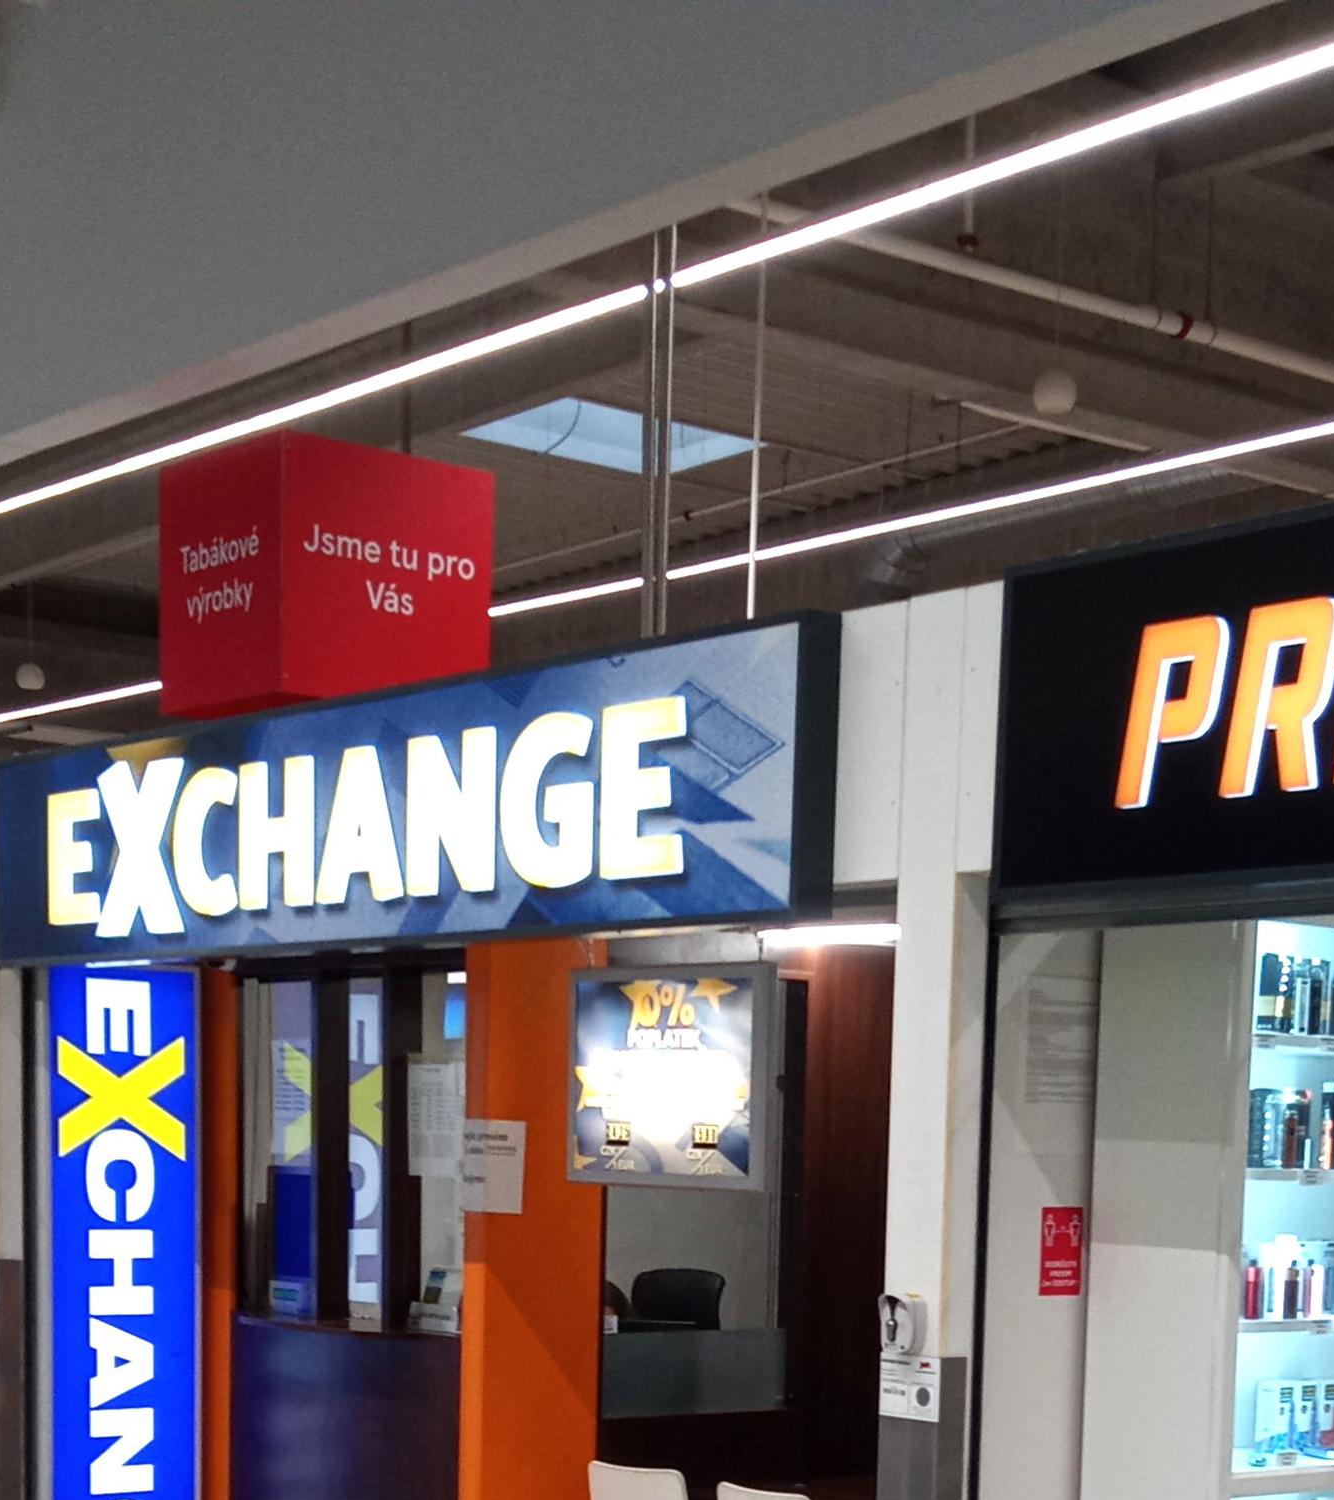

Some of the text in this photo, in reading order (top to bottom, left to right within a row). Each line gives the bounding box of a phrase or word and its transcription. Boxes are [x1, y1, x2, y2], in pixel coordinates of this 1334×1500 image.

[180, 525, 260, 574] Tabákové
[303, 523, 476, 581] Jsme tu pro
[186, 579, 253, 624] výrobky
[365, 579, 415, 616] Vás
[46, 695, 688, 939] EXCHANGE
